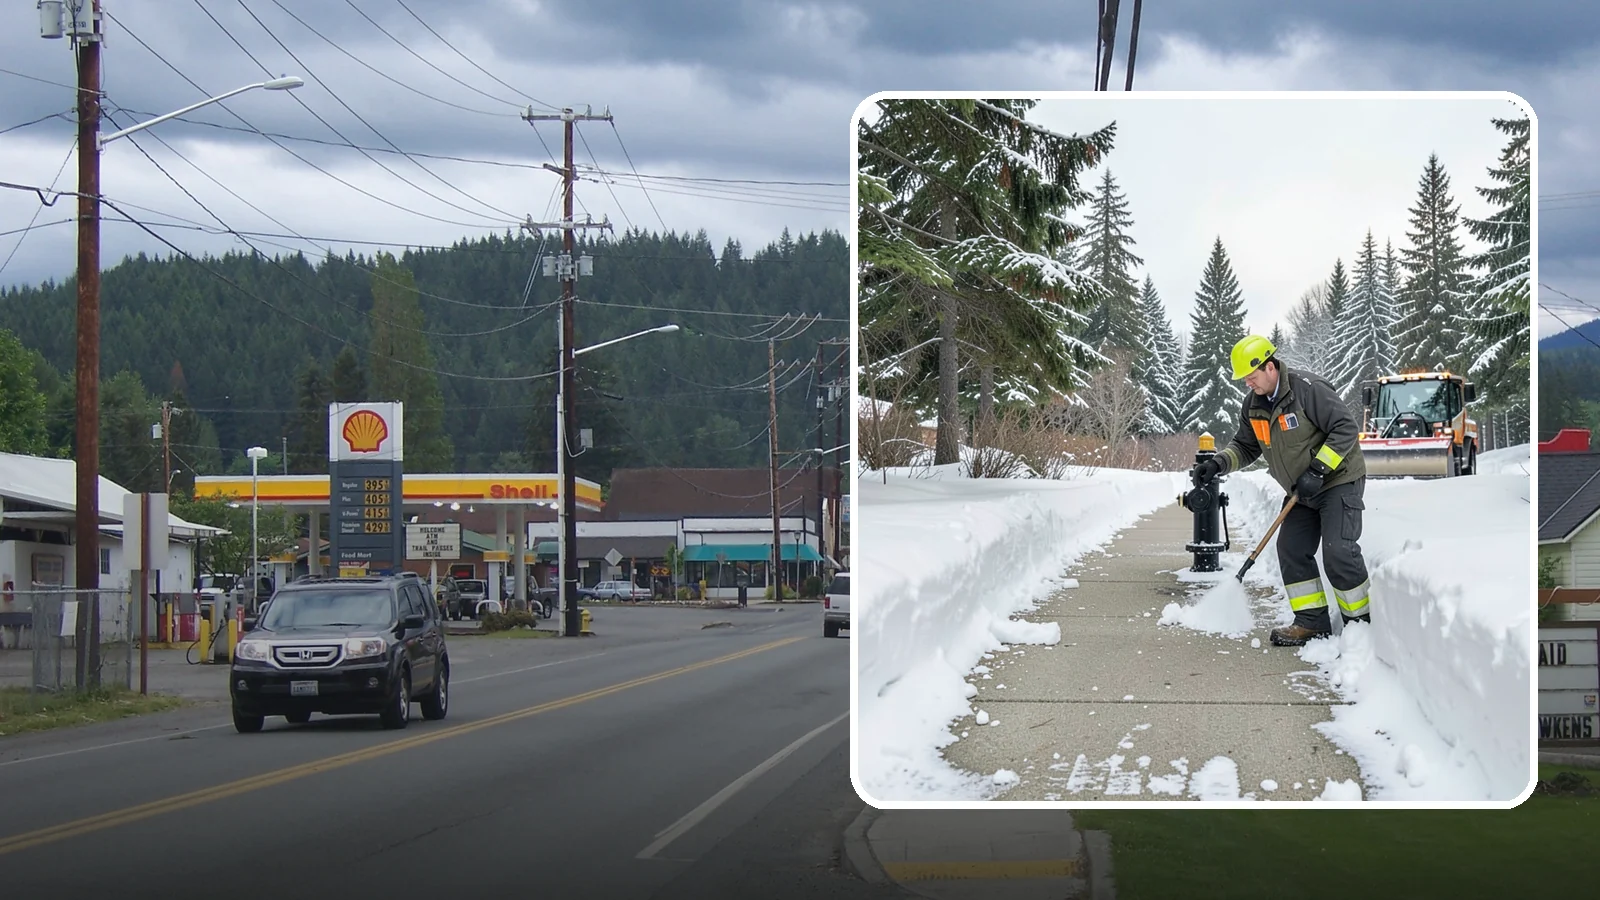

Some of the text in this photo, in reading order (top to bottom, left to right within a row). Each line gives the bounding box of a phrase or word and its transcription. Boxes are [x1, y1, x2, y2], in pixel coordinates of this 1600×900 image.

[365, 480, 384, 490] 395
[489, 484, 547, 498] Shell
[365, 494, 384, 504] 405
[365, 508, 384, 518] 415
[365, 522, 384, 532] 429
